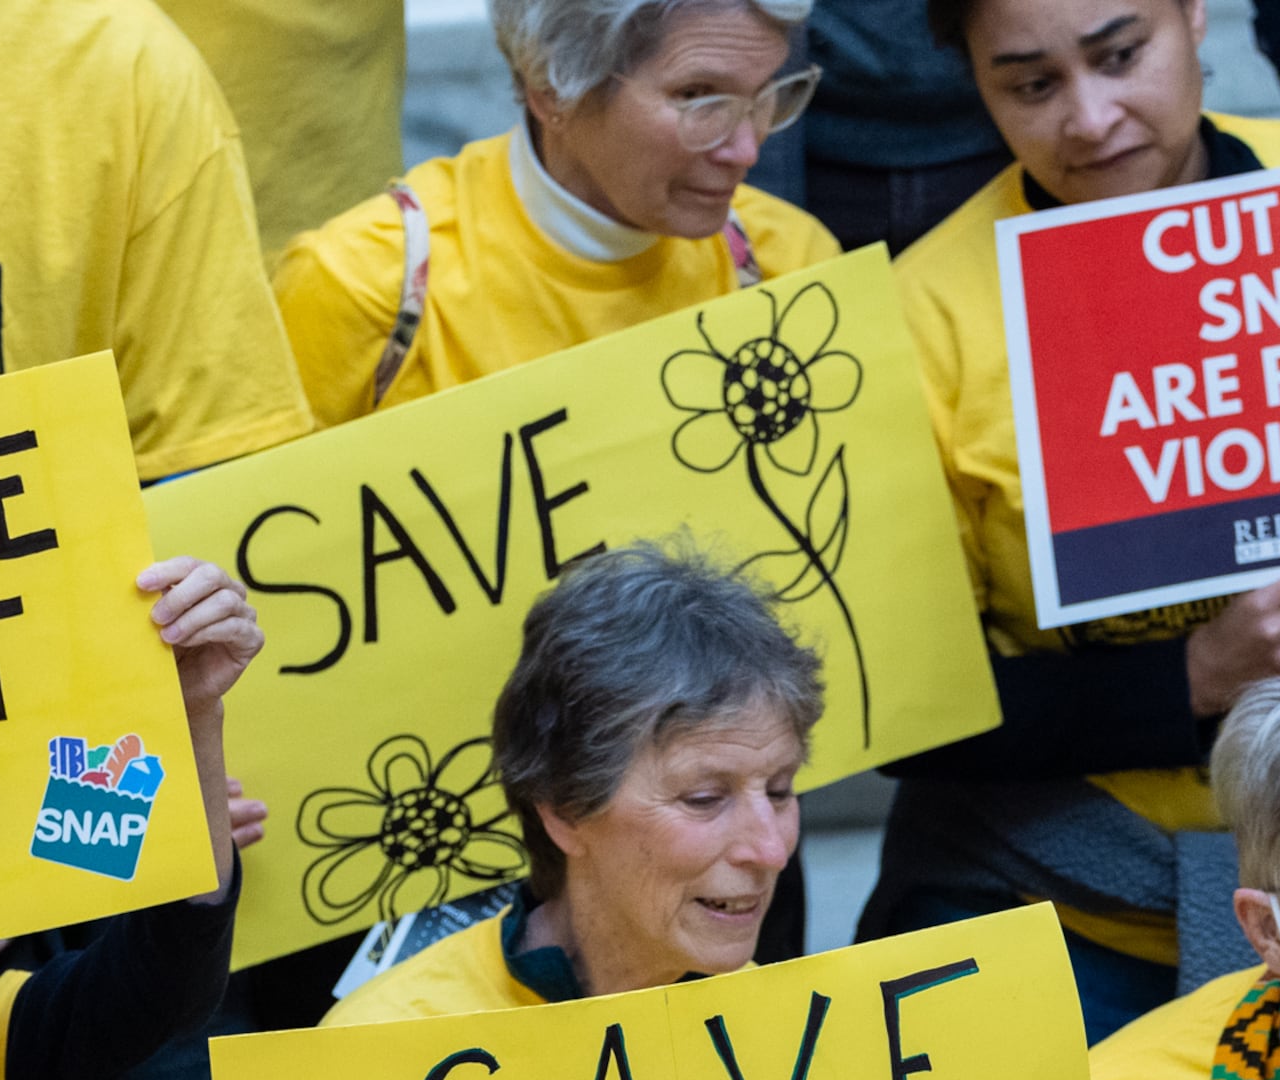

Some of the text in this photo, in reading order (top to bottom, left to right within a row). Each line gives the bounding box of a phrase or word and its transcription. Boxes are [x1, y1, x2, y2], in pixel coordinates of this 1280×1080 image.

[1100, 354, 1244, 437] ARE
[236, 407, 606, 675] SAVE
[35, 807, 148, 847] SNAP
